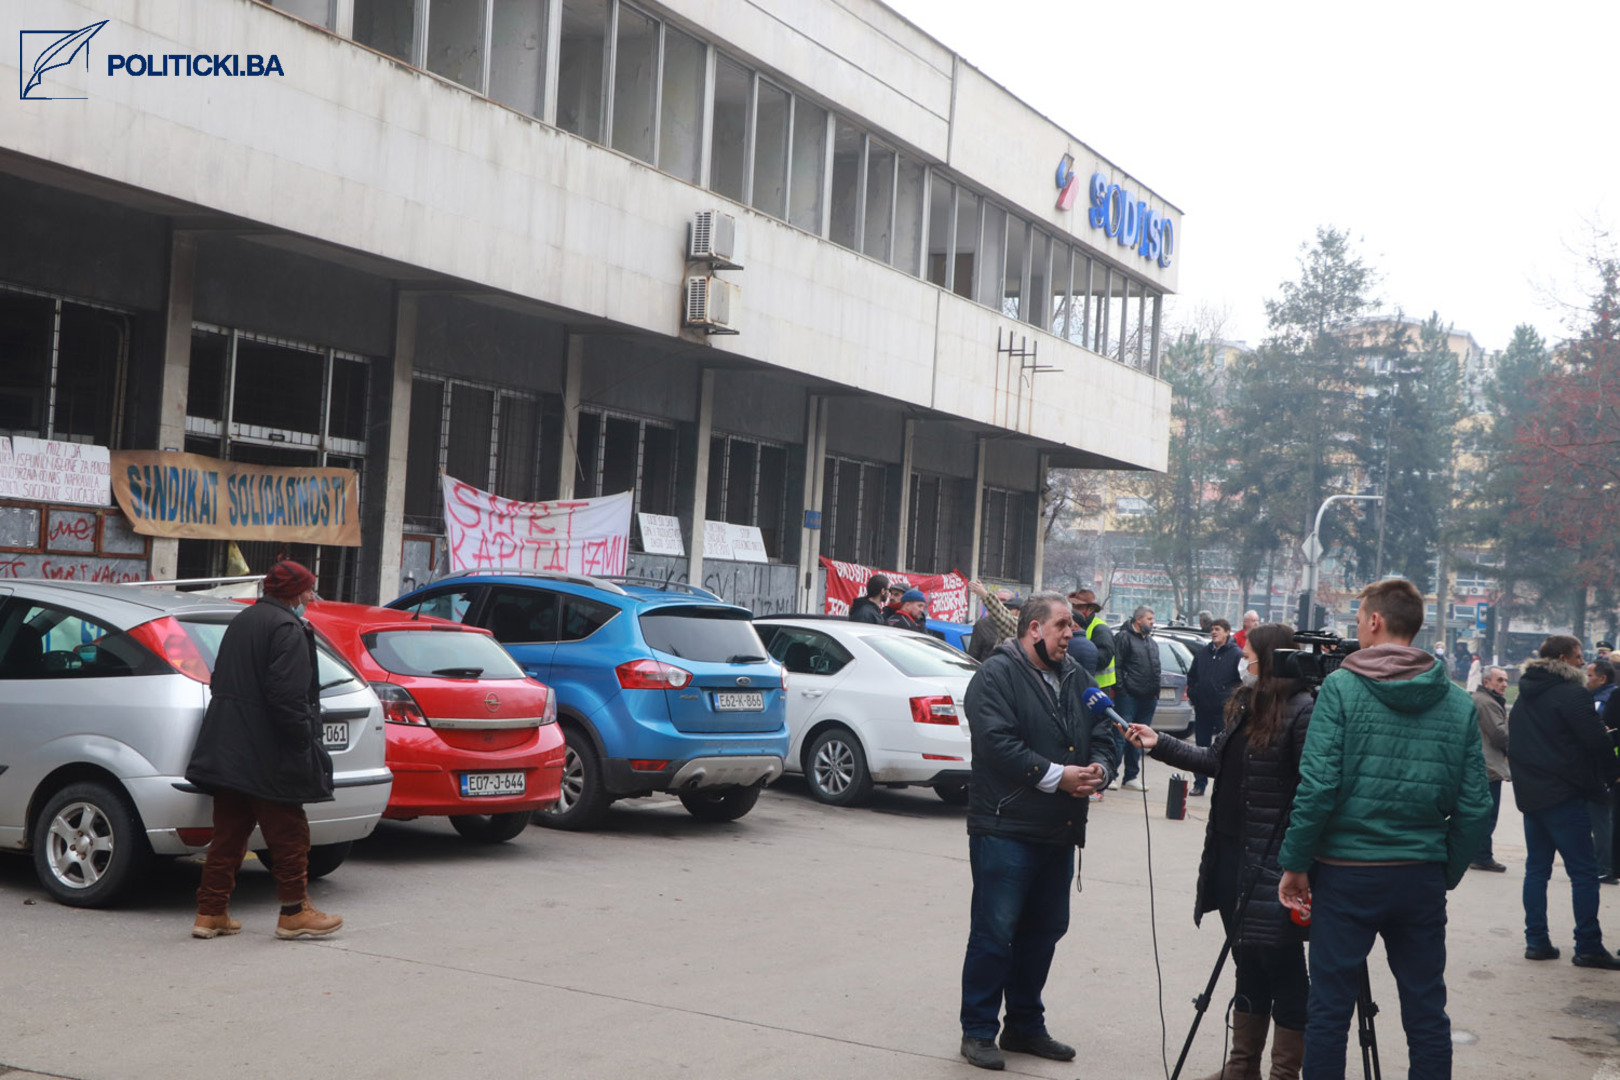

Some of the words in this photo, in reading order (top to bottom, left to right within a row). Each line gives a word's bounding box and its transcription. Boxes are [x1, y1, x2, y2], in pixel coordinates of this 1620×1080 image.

[127, 464, 219, 525] SINDIKAT
[228, 473, 346, 527] SOLIDARNOSTI
[448, 481, 589, 538] SMRT
[719, 692, 762, 708] E62-K-866
[469, 775, 523, 791] E07-J-644
